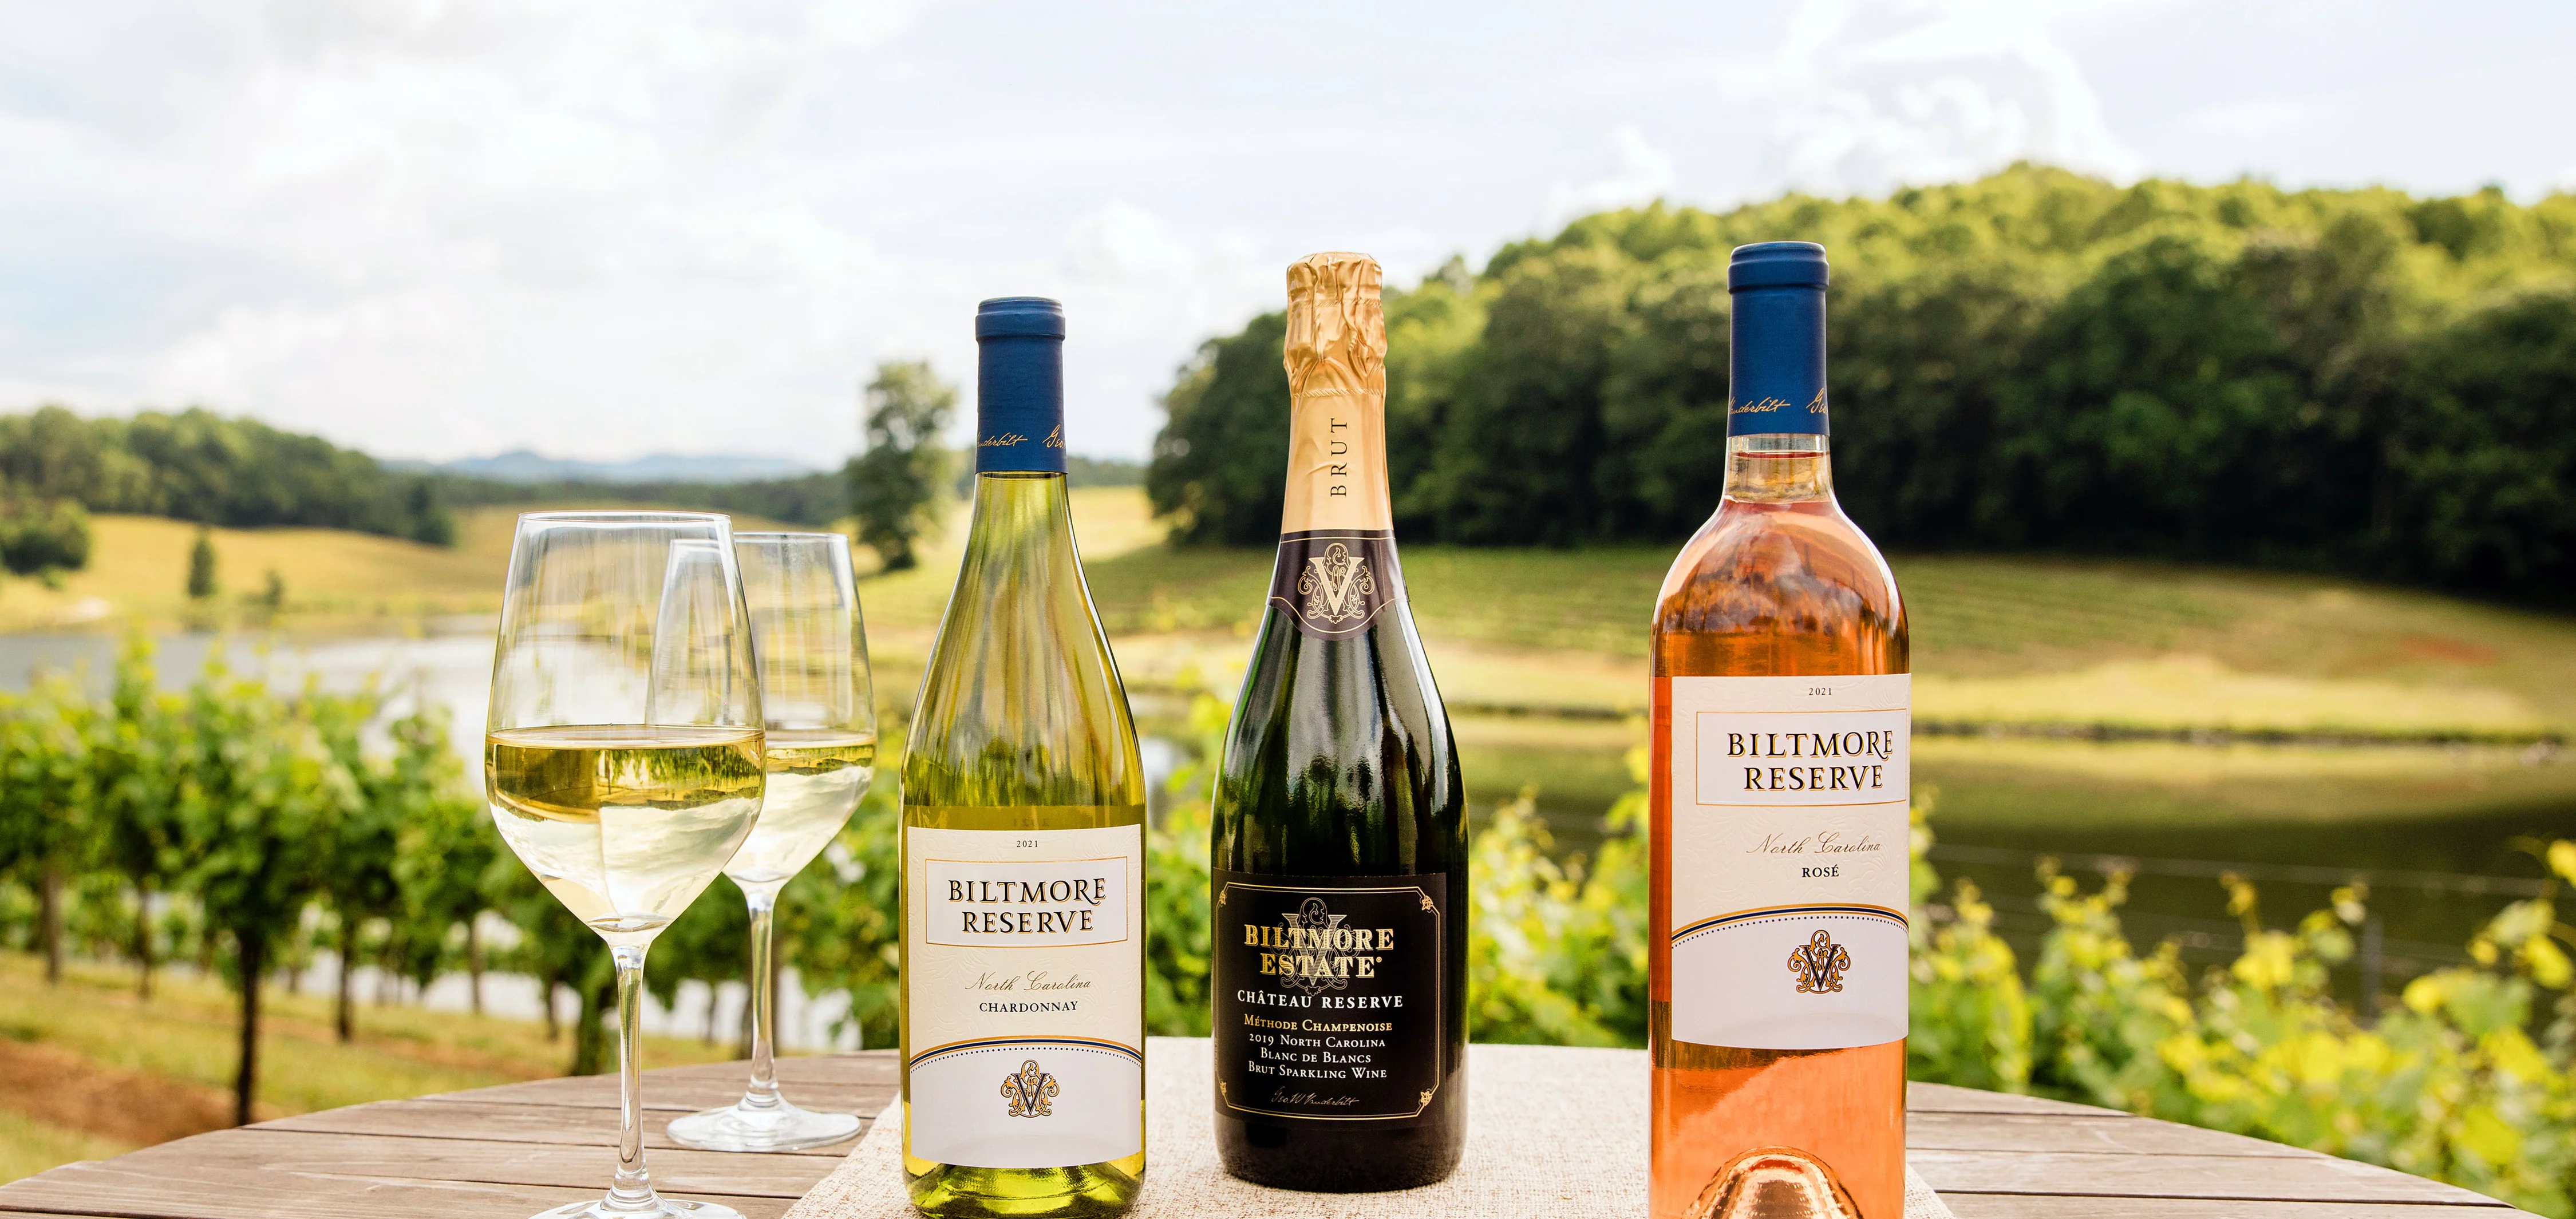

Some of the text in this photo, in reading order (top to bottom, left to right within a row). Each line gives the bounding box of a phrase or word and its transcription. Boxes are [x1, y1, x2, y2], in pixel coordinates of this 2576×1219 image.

[1330, 418, 1348, 497] BRUT
[1808, 687, 1832, 696] 2021
[1726, 730, 1894, 762] BILTMORE
[1743, 765, 1883, 791] RESERVE
[1016, 840, 1038, 848] 2021
[1747, 831, 1881, 854] North Carolina
[1801, 864, 1839, 878] ROSÉ
[948, 877, 1107, 907] BILTMORE
[961, 909, 1094, 935] RESERVE
[1244, 924, 1394, 951] BILTMORE
[964, 970, 1091, 991] North Carolina
[979, 1000, 1078, 1012] CHARDONNAY
[1238, 990, 1403, 1009] CHÂTEAU RESERVE
[1249, 1033, 1274, 1046] 2019
